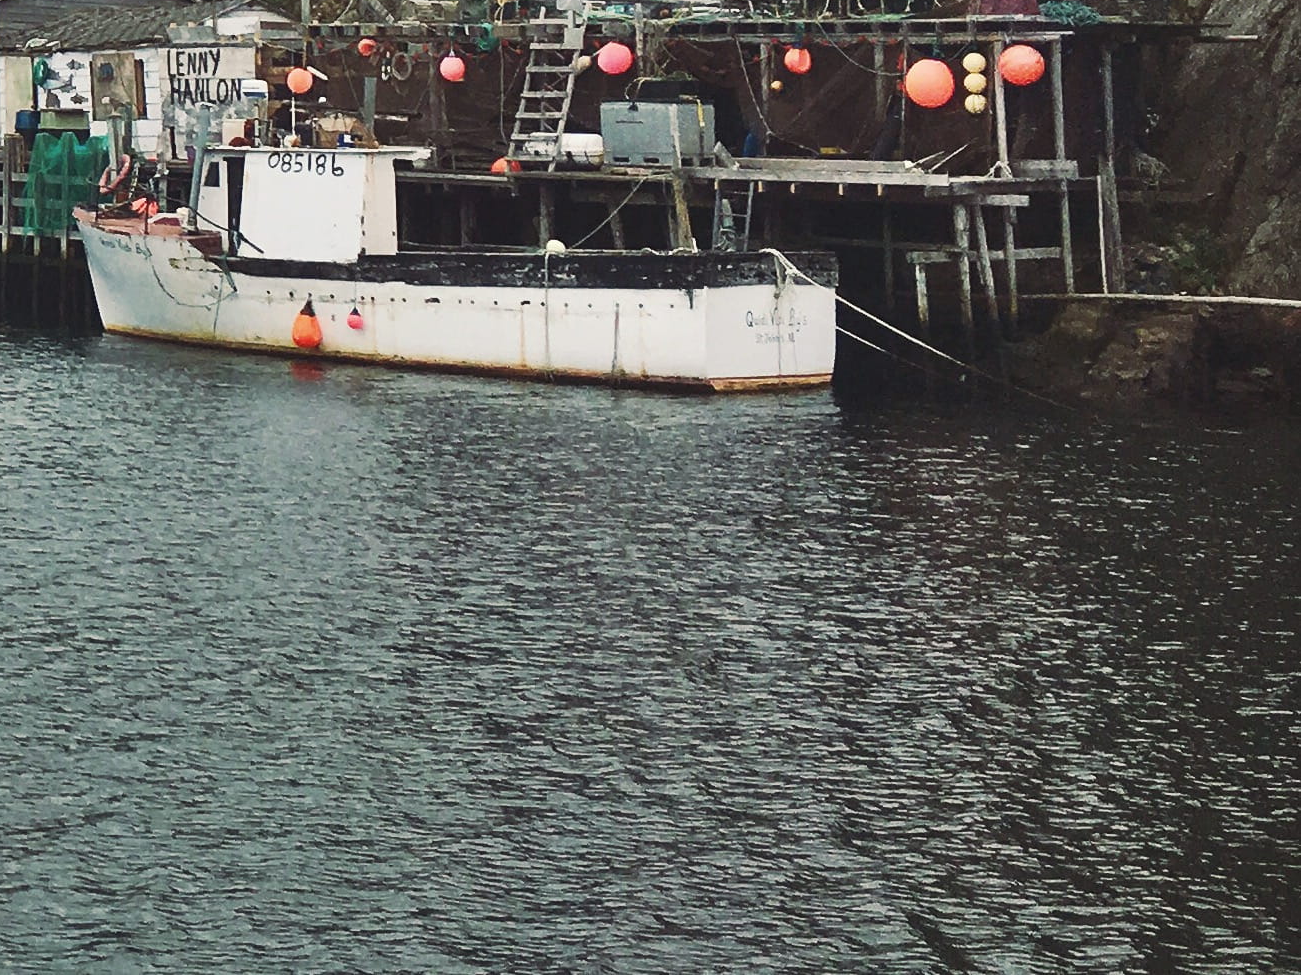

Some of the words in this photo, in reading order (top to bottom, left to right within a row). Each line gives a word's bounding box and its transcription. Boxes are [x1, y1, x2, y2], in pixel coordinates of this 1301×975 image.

[167, 48, 221, 77] LENNY
[170, 78, 242, 107] HANLON
[268, 152, 344, 177] 085186
